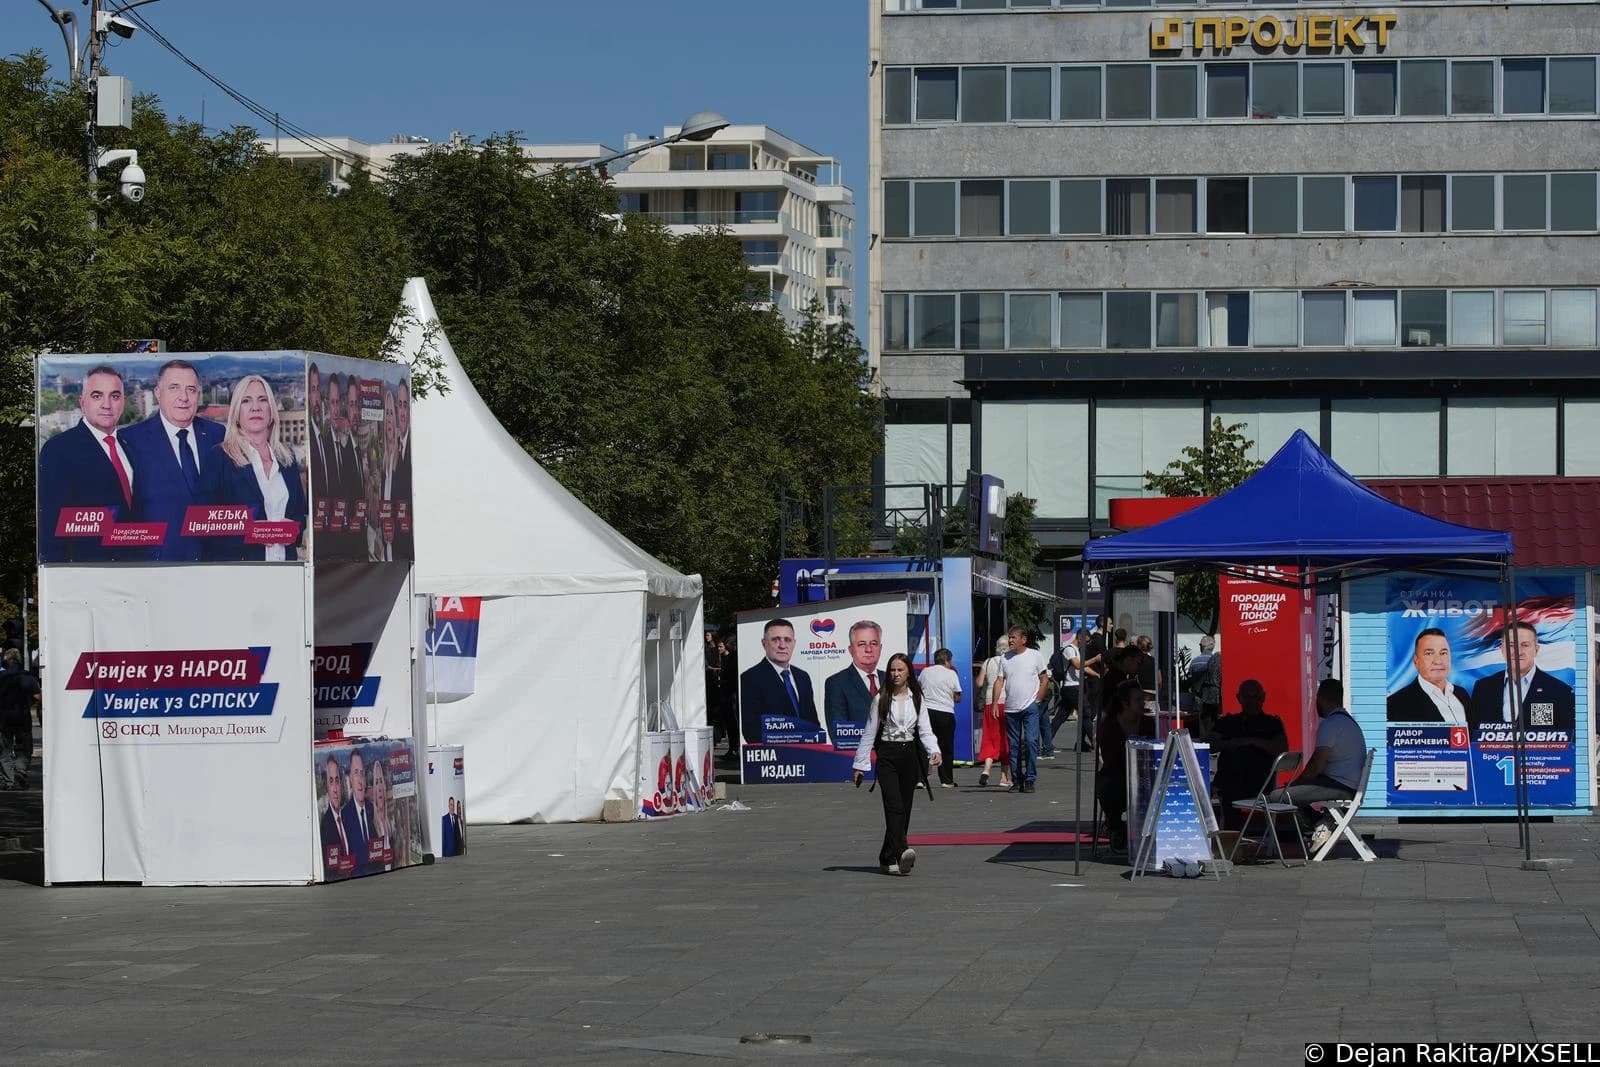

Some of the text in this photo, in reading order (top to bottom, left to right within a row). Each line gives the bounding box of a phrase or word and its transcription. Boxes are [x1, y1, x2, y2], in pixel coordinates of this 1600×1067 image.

[1193, 15, 1397, 51] ПРОЈЕКТ
[75, 511, 104, 522] САВО
[208, 509, 248, 520] ЖЕЉКА
[65, 523, 100, 533] Минић
[189, 520, 245, 534] Цвијановић
[1231, 593, 1286, 603] ПОРОДИЦА
[1400, 590, 1454, 598] СТРАНКА
[1238, 602, 1279, 611] ПРАВДА
[1401, 600, 1498, 618] ЖИВОТ
[1241, 611, 1277, 620] ПОНОС
[809, 642, 837, 650] ВОЉА
[85, 656, 247, 682] Увијек уз НАРОД
[103, 689, 260, 713] Увијек уз СРПСКУ
[333, 714, 370, 725] Додик
[121, 723, 267, 738] СНСД Милорад Додик
[765, 722, 795, 730] ЂАЈИЋ
[814, 734, 820, 743] 1
[1394, 730, 1423, 738] ДАВОР
[1454, 732, 1462, 744] 1
[1393, 738, 1450, 747] ДРАГИЧЕВИЋ
[747, 749, 777, 762] НЕМА
[1482, 753, 1499, 761] Број
[761, 764, 805, 779] ИЗДАЈЕ!
[1495, 755, 1515, 785] 1
